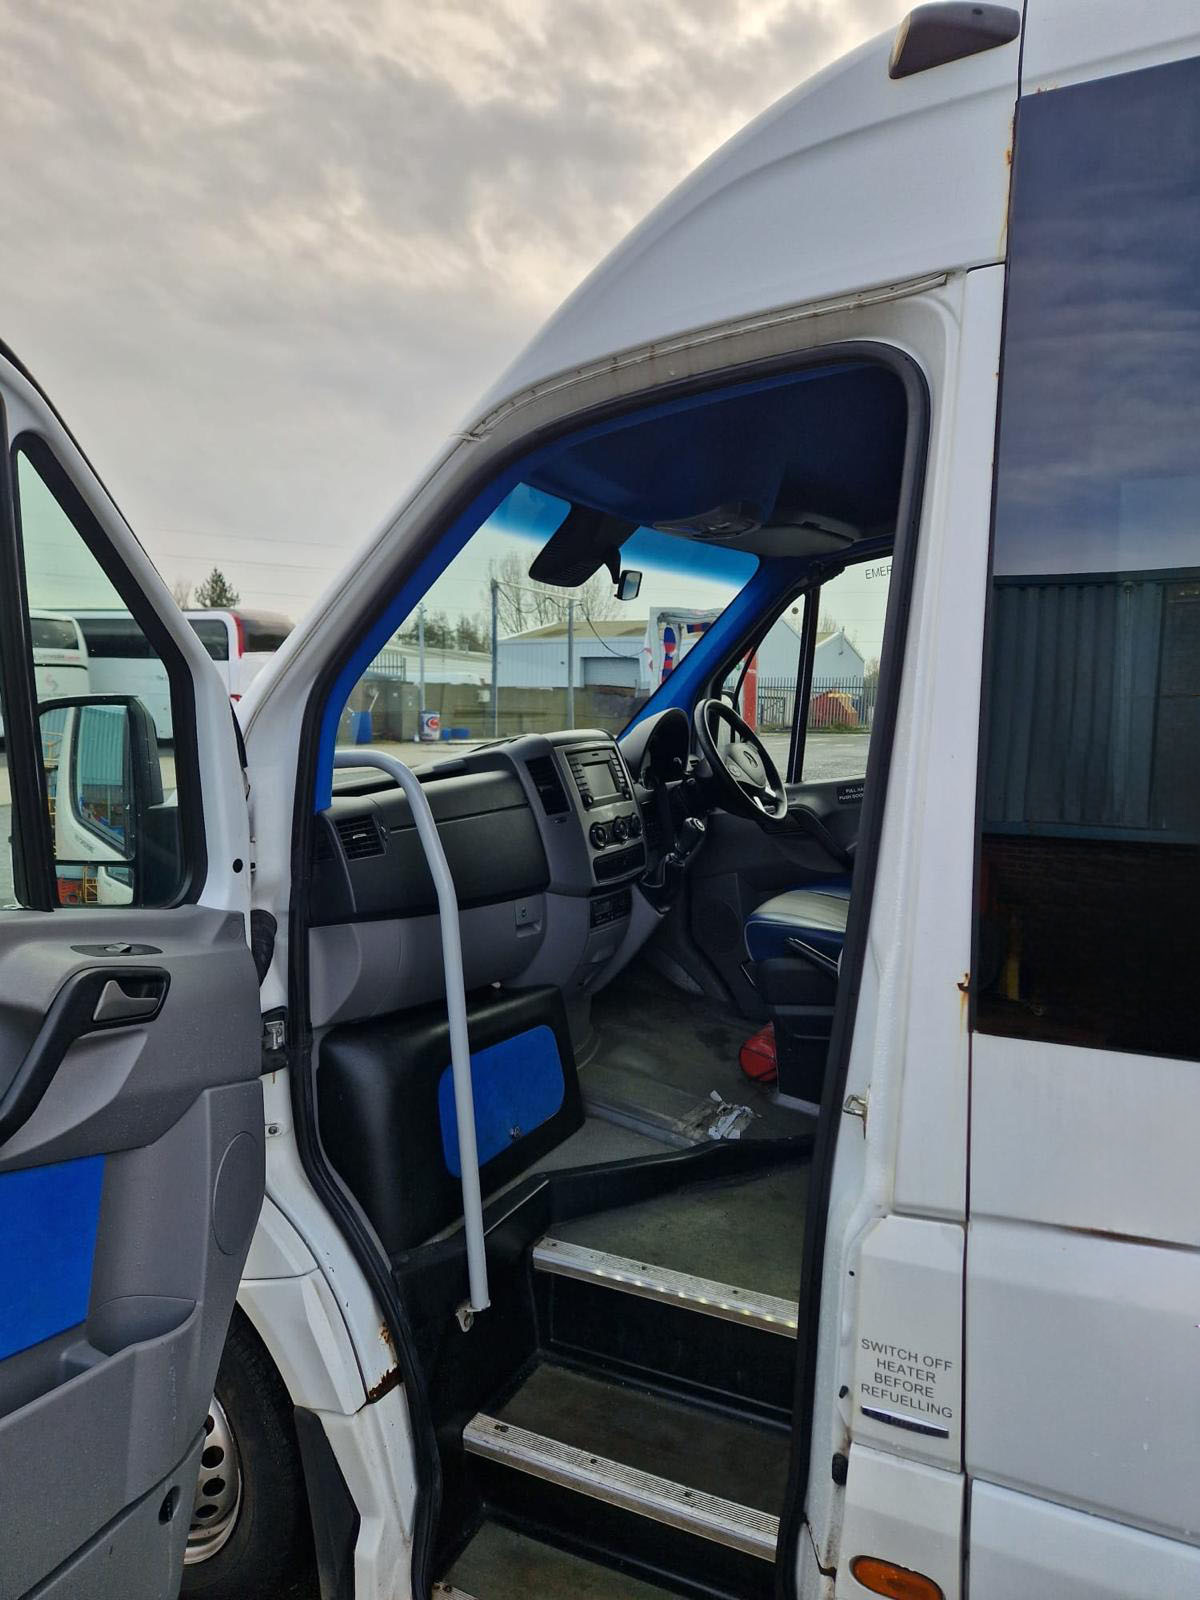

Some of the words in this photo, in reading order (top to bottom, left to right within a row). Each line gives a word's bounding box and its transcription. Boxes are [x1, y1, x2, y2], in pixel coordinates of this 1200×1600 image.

[861, 1338, 918, 1363] SWITCH
[923, 1356, 953, 1371] OFF
[874, 1372, 935, 1398] BEFORE
[876, 1358, 936, 1383] HEATER
[861, 1383, 953, 1418] REFUELLING
